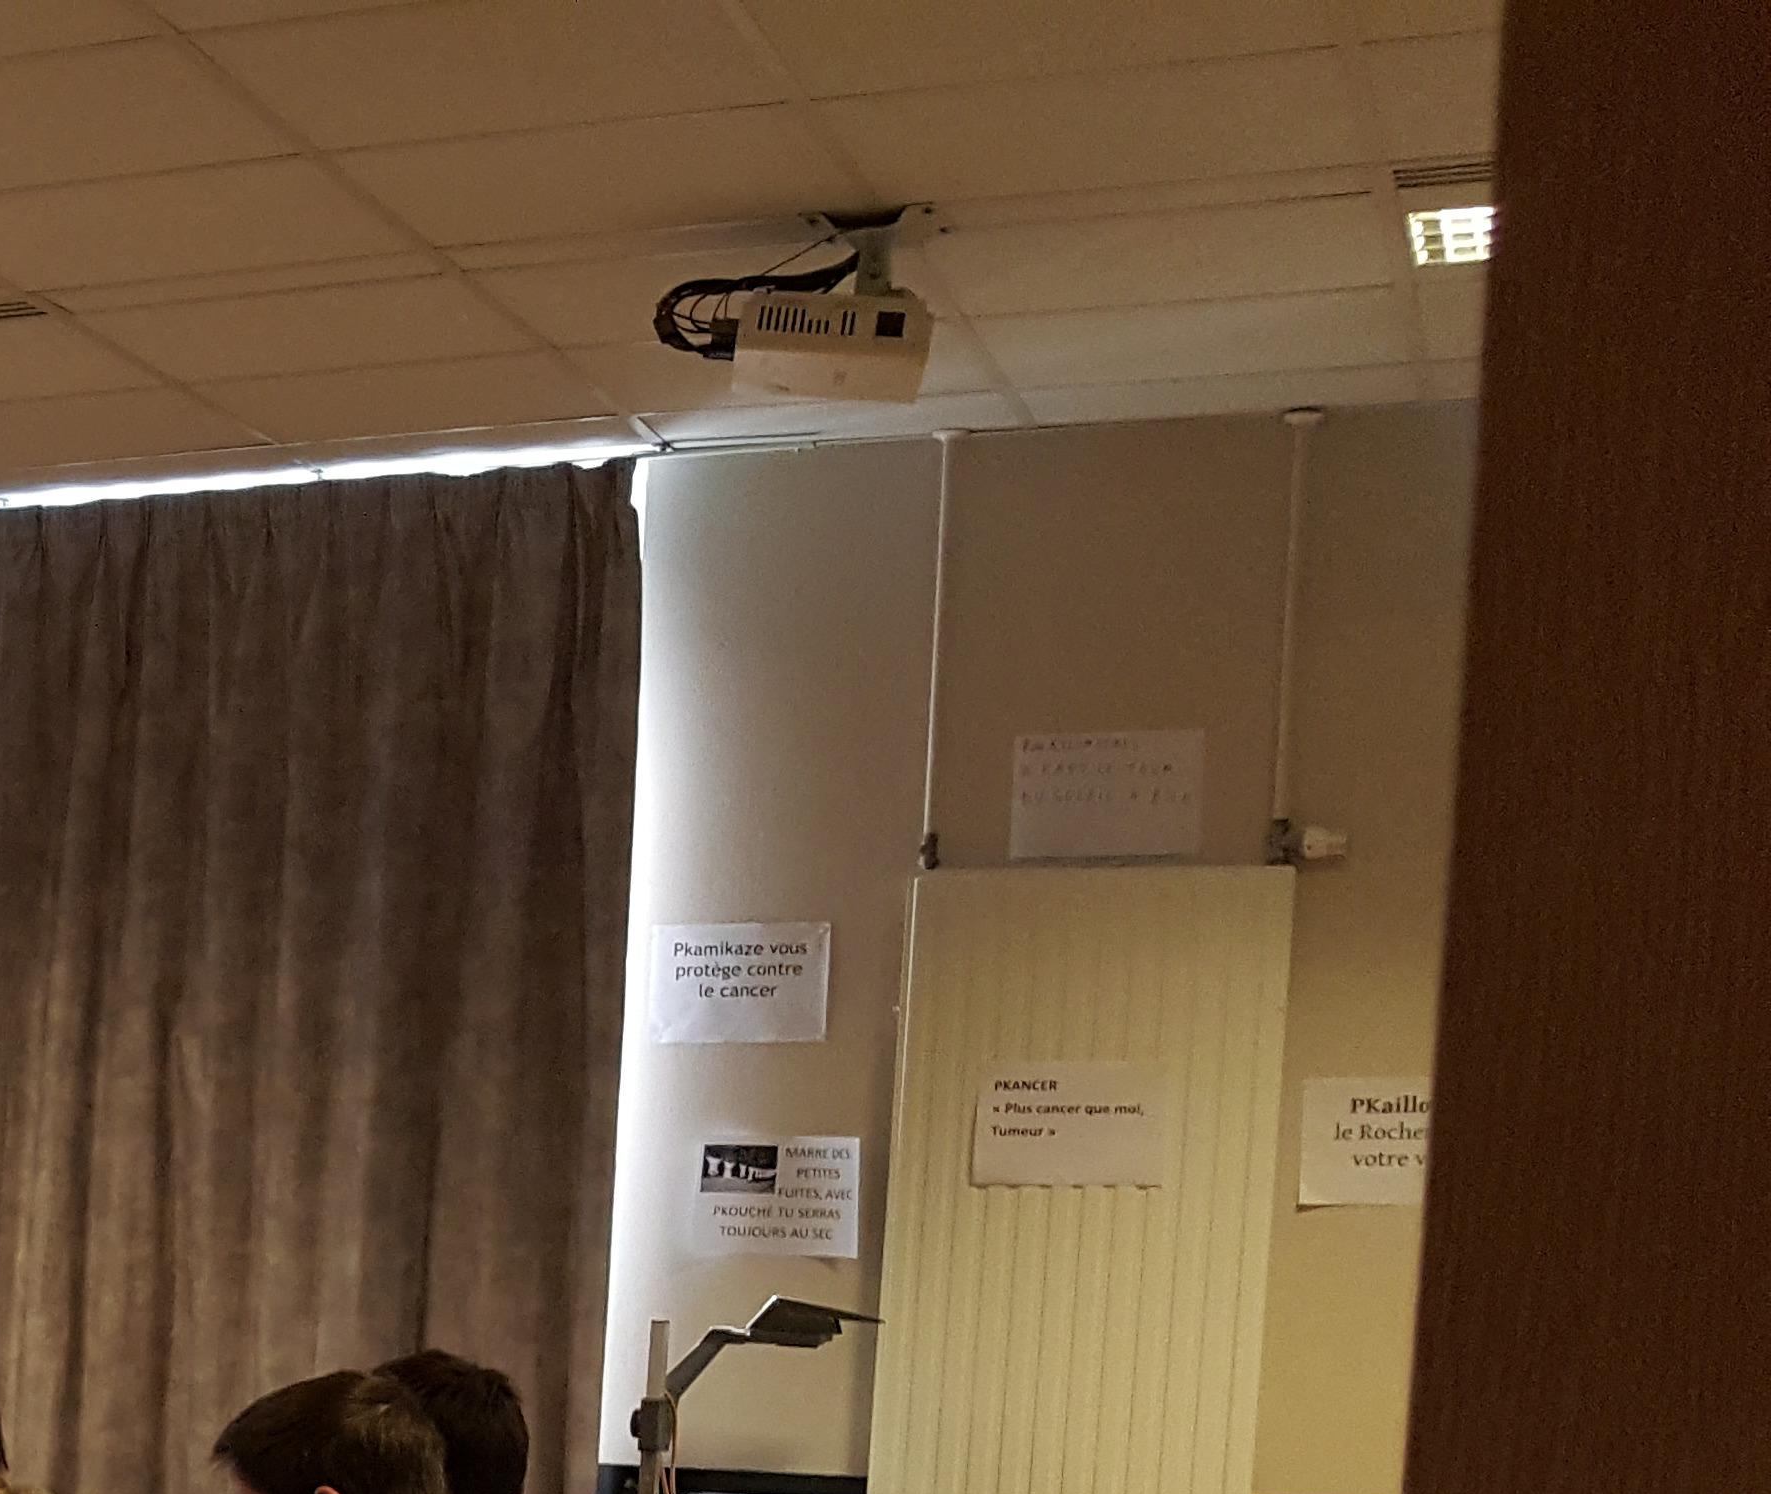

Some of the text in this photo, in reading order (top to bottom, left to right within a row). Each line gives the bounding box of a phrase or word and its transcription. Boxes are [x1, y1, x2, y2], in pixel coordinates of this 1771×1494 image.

[673, 941, 807, 957] Pkamikaze vous
[675, 961, 804, 981] protège contre
[699, 983, 778, 998] le cancer
[994, 1079, 1057, 1091] PKANCER
[1005, 1102, 1032, 1114] Plus
[1036, 1104, 1081, 1114] cancer
[1084, 1104, 1109, 1116] que
[991, 1125, 1043, 1137] Tumeur
[1335, 1121, 1352, 1140] le
[785, 1148, 850, 1160] MARRE DES
[1353, 1152, 1409, 1167] votre
[795, 1167, 841, 1181] PETITES
[825, 1189, 853, 1201] AVEC
[778, 1207, 795, 1218] TU
[719, 1225, 834, 1241] TOUJOURS AU SEC
